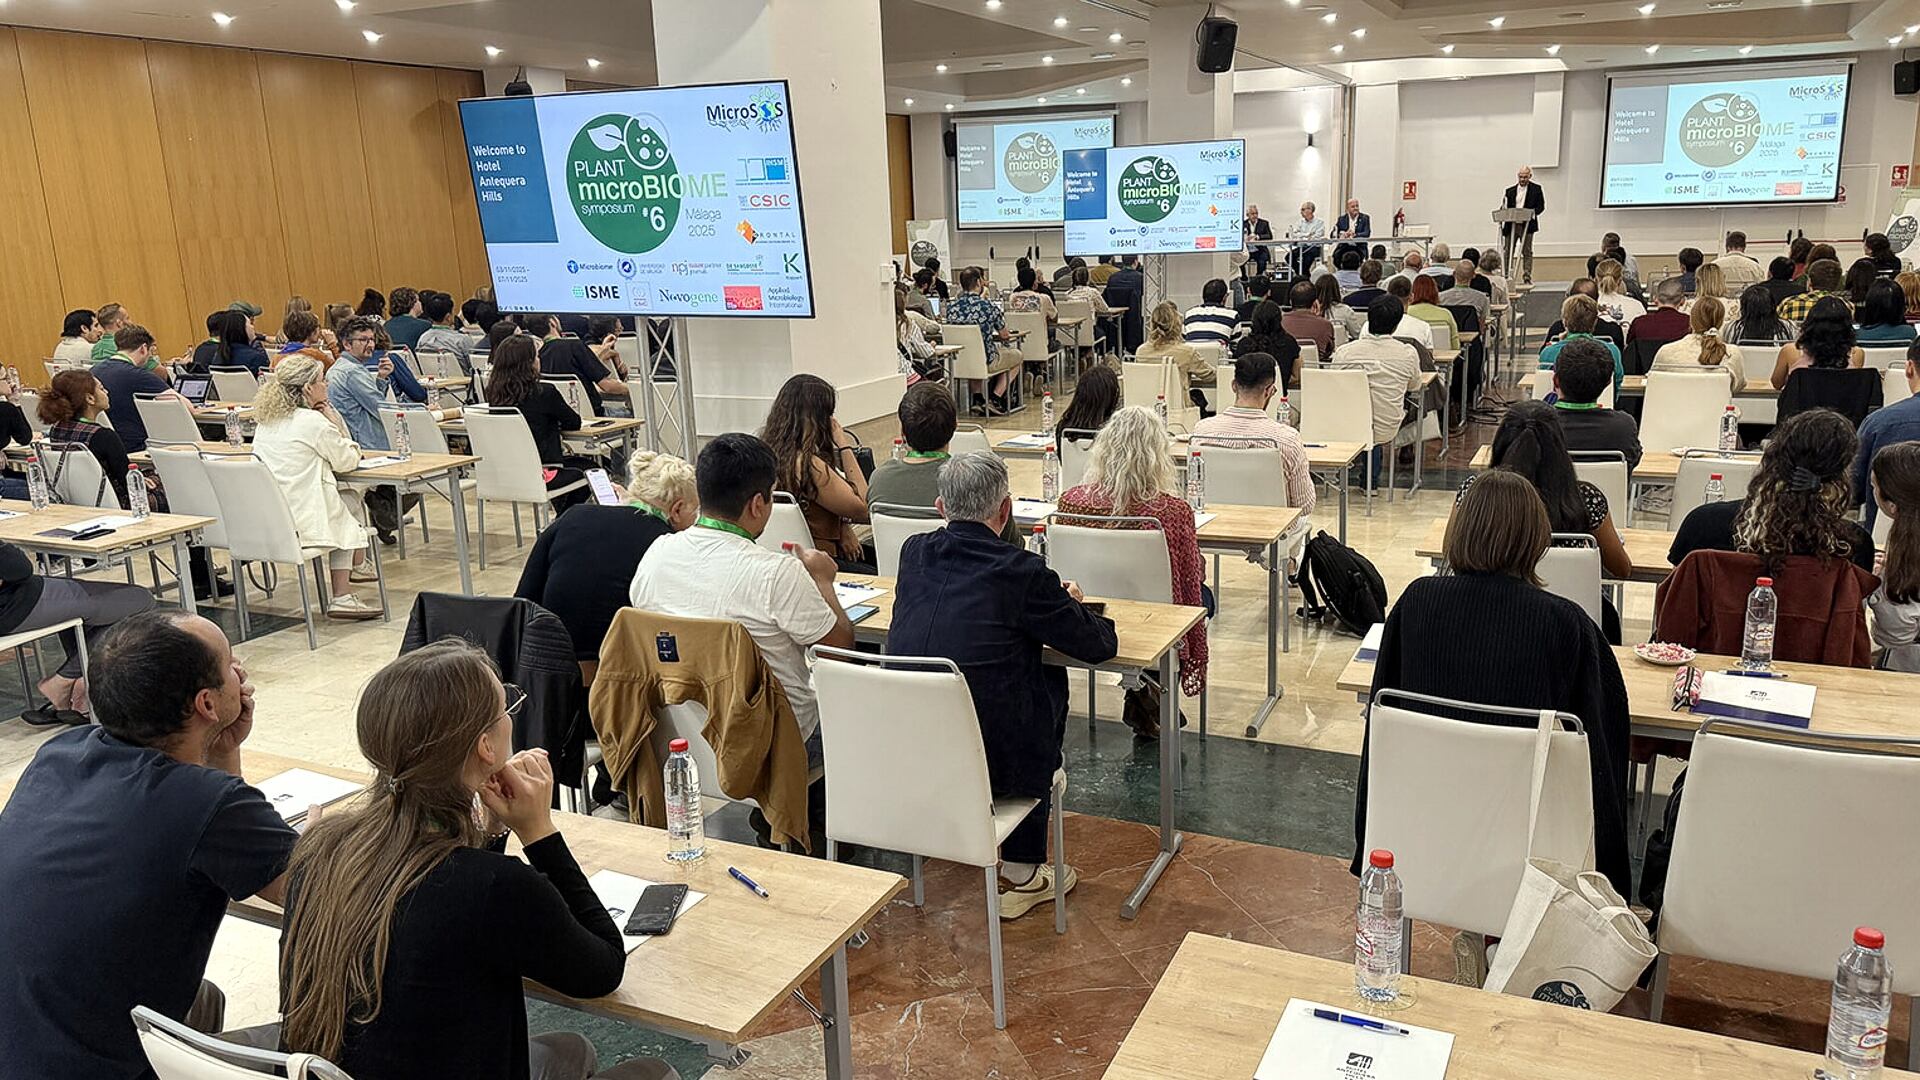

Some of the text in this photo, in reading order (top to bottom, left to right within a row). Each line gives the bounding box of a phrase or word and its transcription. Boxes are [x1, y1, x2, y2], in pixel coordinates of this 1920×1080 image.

[1686, 116, 1725, 128] PLANT
[1686, 122, 1795, 140] microBIOME
[1807, 131, 1837, 140] CSIC
[472, 144, 527, 156] Welcome to
[1008, 151, 1034, 160] PLANT
[475, 160, 501, 172] Hotel
[574, 159, 626, 177] PLANT
[1822, 162, 1834, 174] K
[479, 176, 527, 189] Antequera
[578, 173, 728, 201] microBIOME
[1123, 177, 1153, 187] PLANT
[1123, 183, 1206, 199] microBIOME
[1673, 185, 1700, 194] ISME
[481, 191, 503, 202] Hills
[749, 194, 790, 207] CSIC
[581, 203, 636, 217] symposium
[685, 207, 722, 223] Málaga
[688, 225, 717, 237] 2025
[783, 252, 801, 274] K
[584, 285, 621, 299] ISME
[659, 288, 719, 307] Novogene
